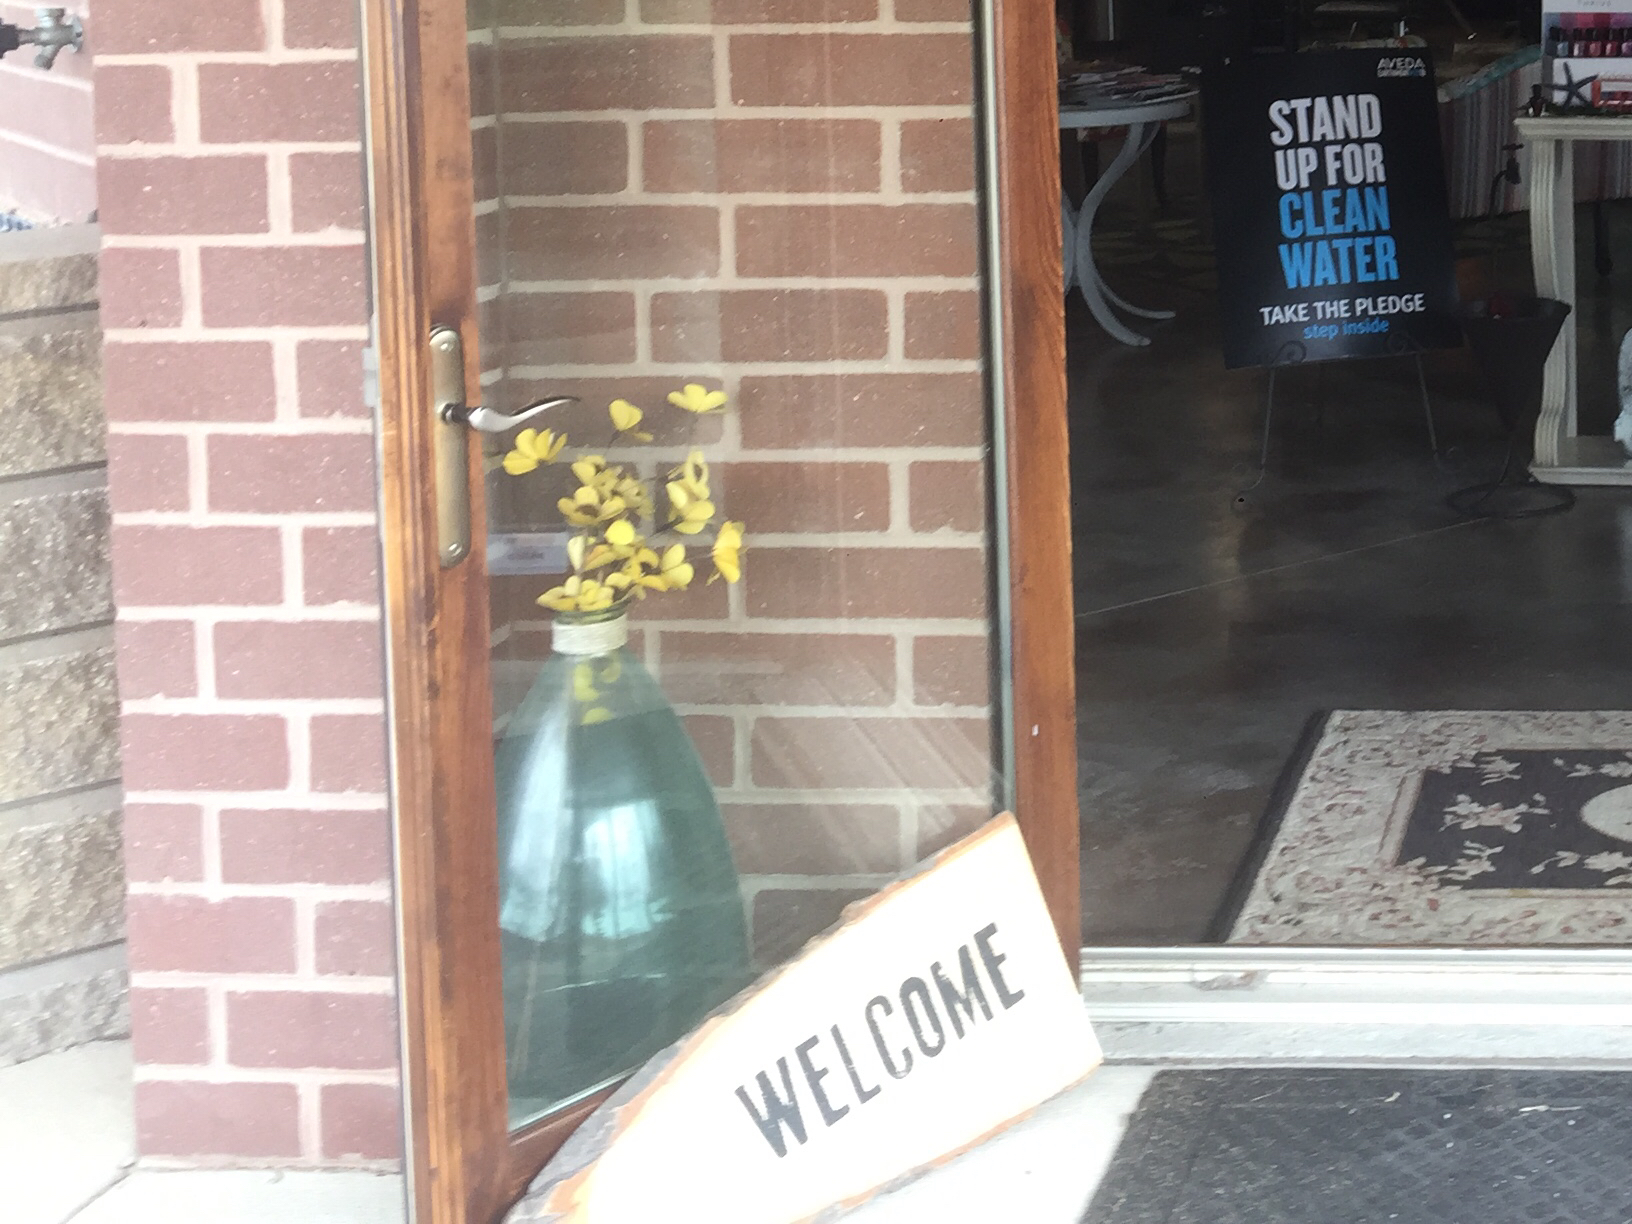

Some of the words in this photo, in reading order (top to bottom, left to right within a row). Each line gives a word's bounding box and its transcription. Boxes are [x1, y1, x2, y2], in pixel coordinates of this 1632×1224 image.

[1377, 57, 1426, 70] AVEDA
[1268, 93, 1384, 146] STAND
[1273, 146, 1318, 191] UP
[1324, 142, 1387, 187] FOR
[1278, 186, 1391, 239] CLEAN
[1277, 235, 1400, 289] WATER
[1259, 302, 1311, 326] TAKE
[1313, 299, 1352, 321] THE
[1354, 293, 1427, 316] PLEDGE
[1303, 322, 1340, 341] step
[1342, 316, 1390, 336] inside
[734, 921, 1025, 1159] WELCOME
